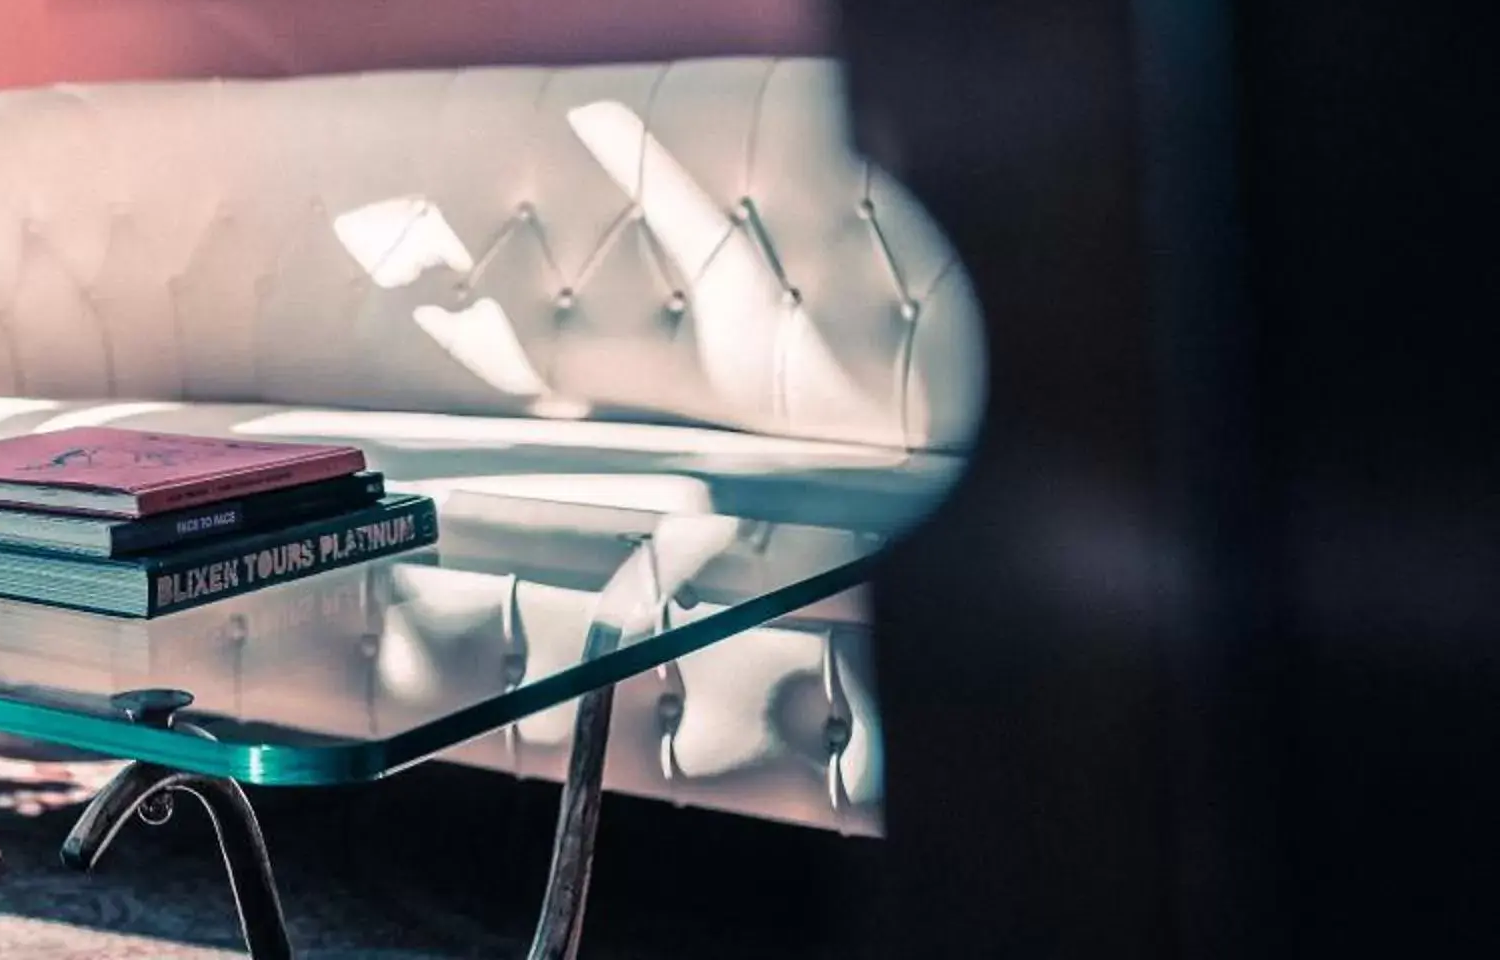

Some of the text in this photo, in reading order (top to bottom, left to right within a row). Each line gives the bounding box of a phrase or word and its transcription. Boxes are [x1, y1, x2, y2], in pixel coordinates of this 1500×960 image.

[200, 515, 213, 529] TO
[157, 558, 239, 607] BLIXEN
[242, 539, 316, 584] TOURS
[320, 515, 416, 563] PLATINUM
